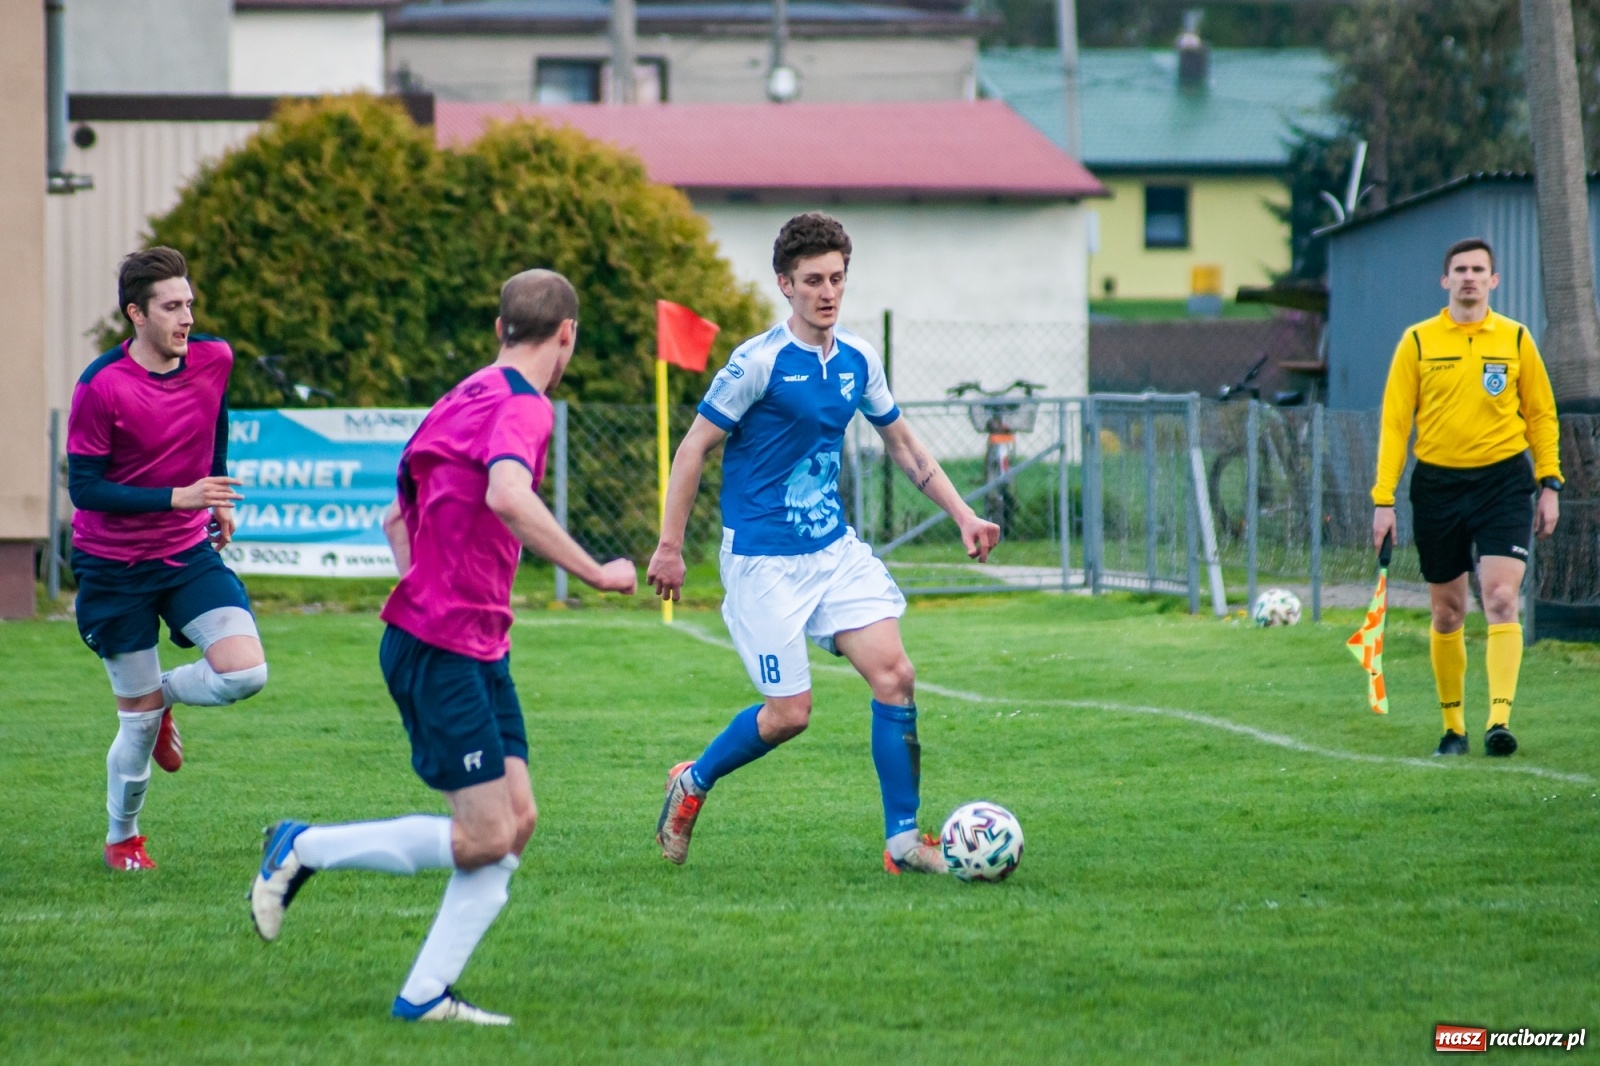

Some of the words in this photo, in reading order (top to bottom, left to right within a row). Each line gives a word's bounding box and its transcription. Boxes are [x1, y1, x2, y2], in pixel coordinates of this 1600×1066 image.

[229, 420, 260, 443] KI
[250, 548, 301, 565] 9002
[758, 654, 781, 684] 18
